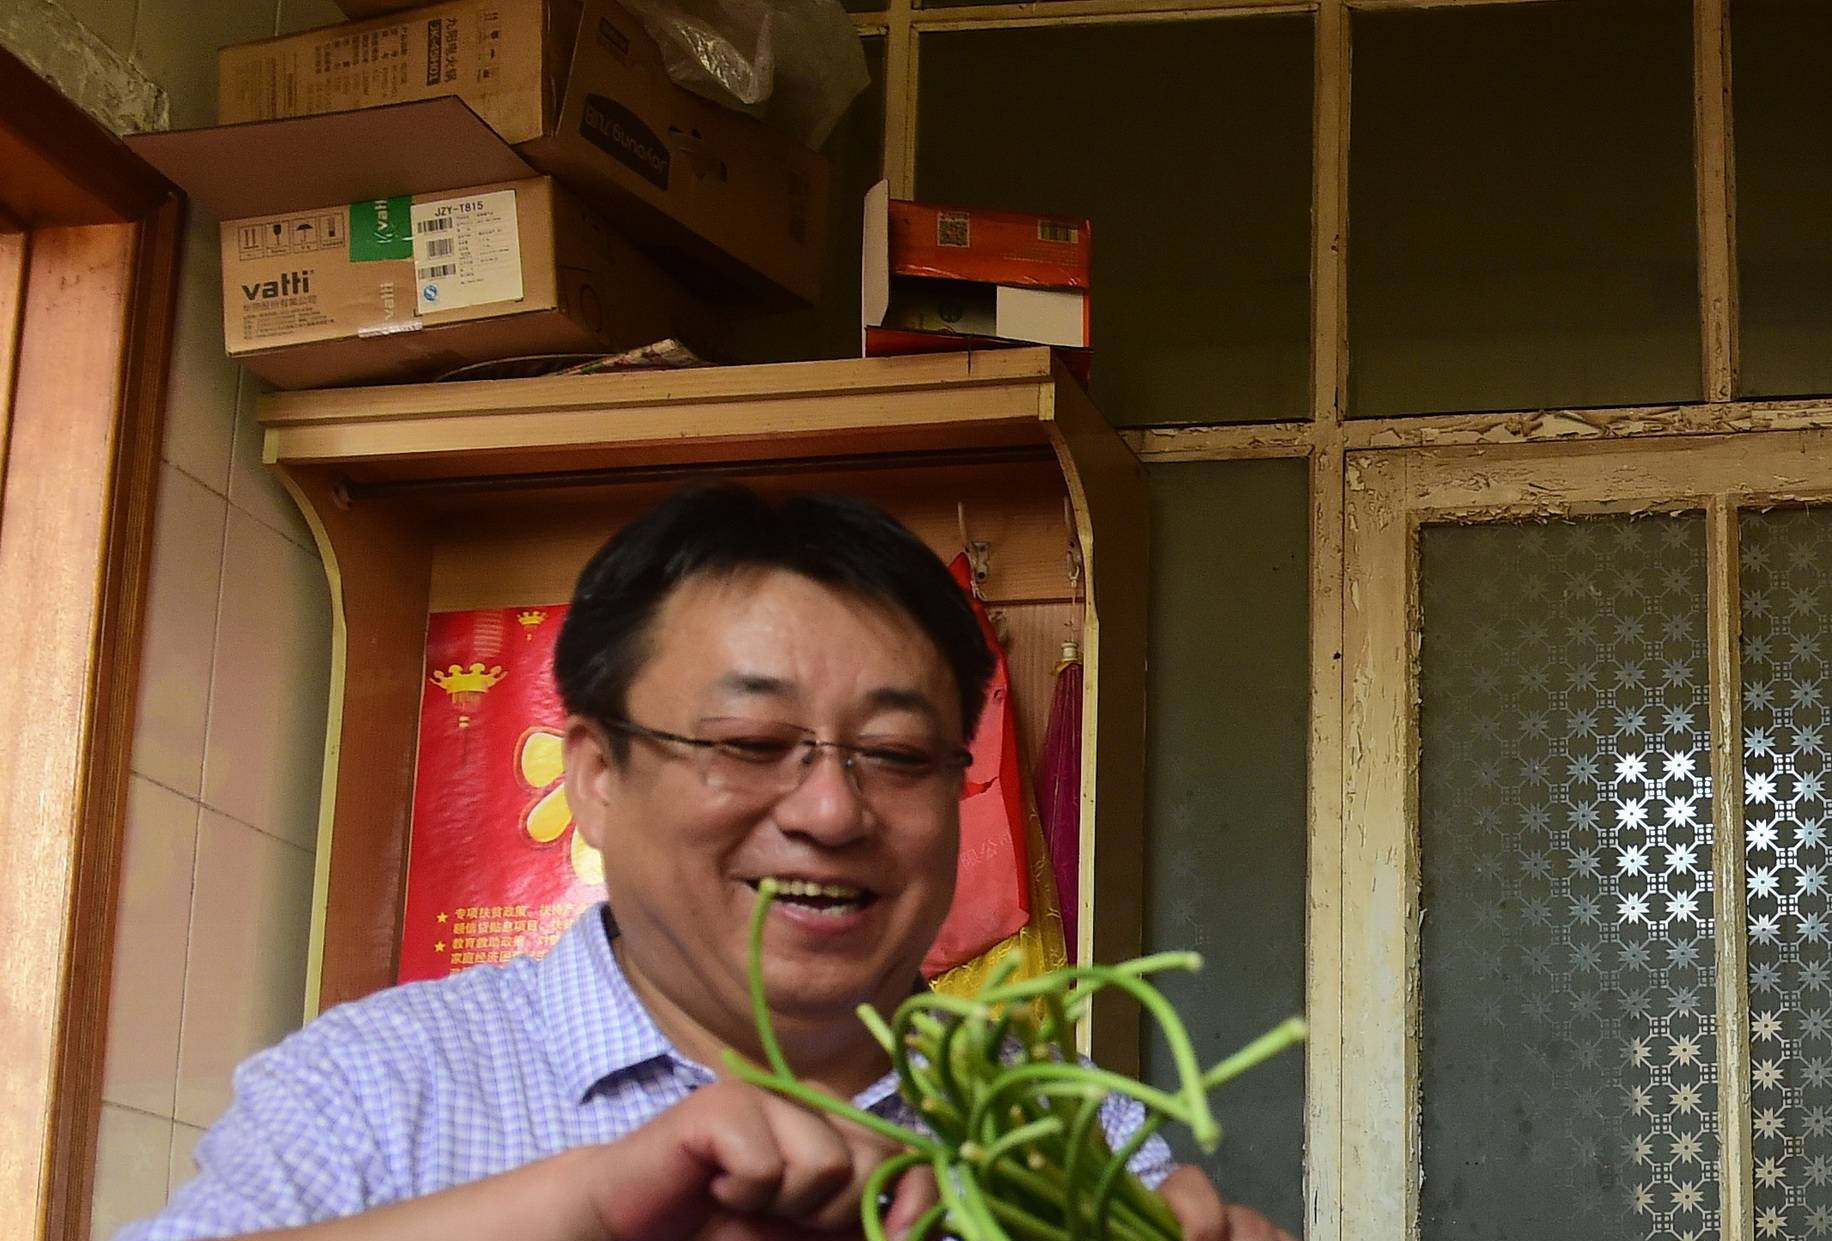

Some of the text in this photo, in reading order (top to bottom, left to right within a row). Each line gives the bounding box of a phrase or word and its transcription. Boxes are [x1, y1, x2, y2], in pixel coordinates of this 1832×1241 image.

[445, 18, 458, 82] 九阳电火锅
[435, 201, 483, 217] JZY-T815
[242, 270, 309, 300] vatti
